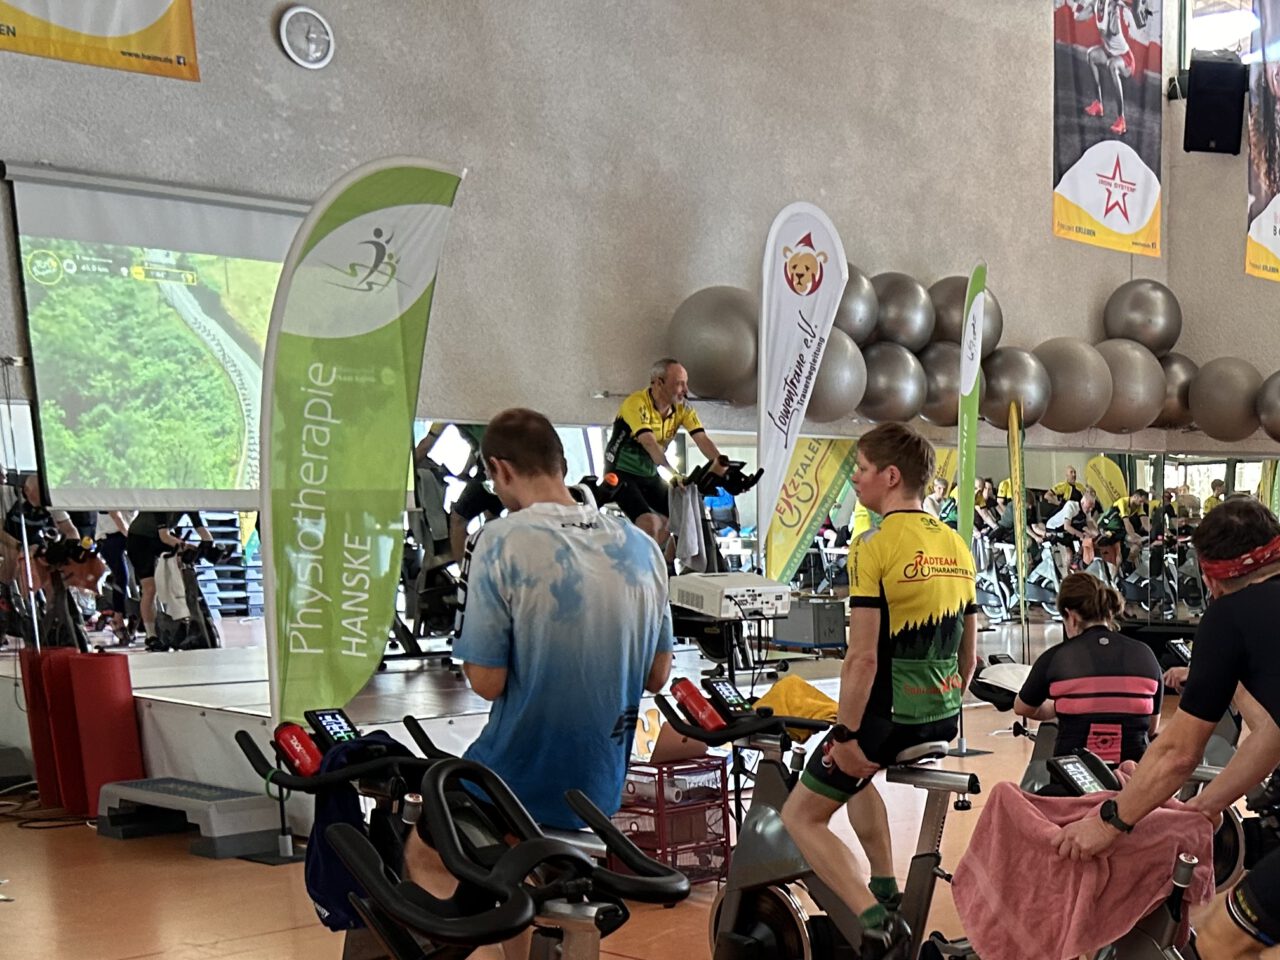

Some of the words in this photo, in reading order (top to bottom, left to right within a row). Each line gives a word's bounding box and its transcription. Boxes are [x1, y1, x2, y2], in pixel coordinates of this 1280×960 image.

[797, 336, 826, 407] Trauerbegleitung
[289, 363, 341, 654] Physiotherapie
[341, 532, 372, 658] HANSKE
